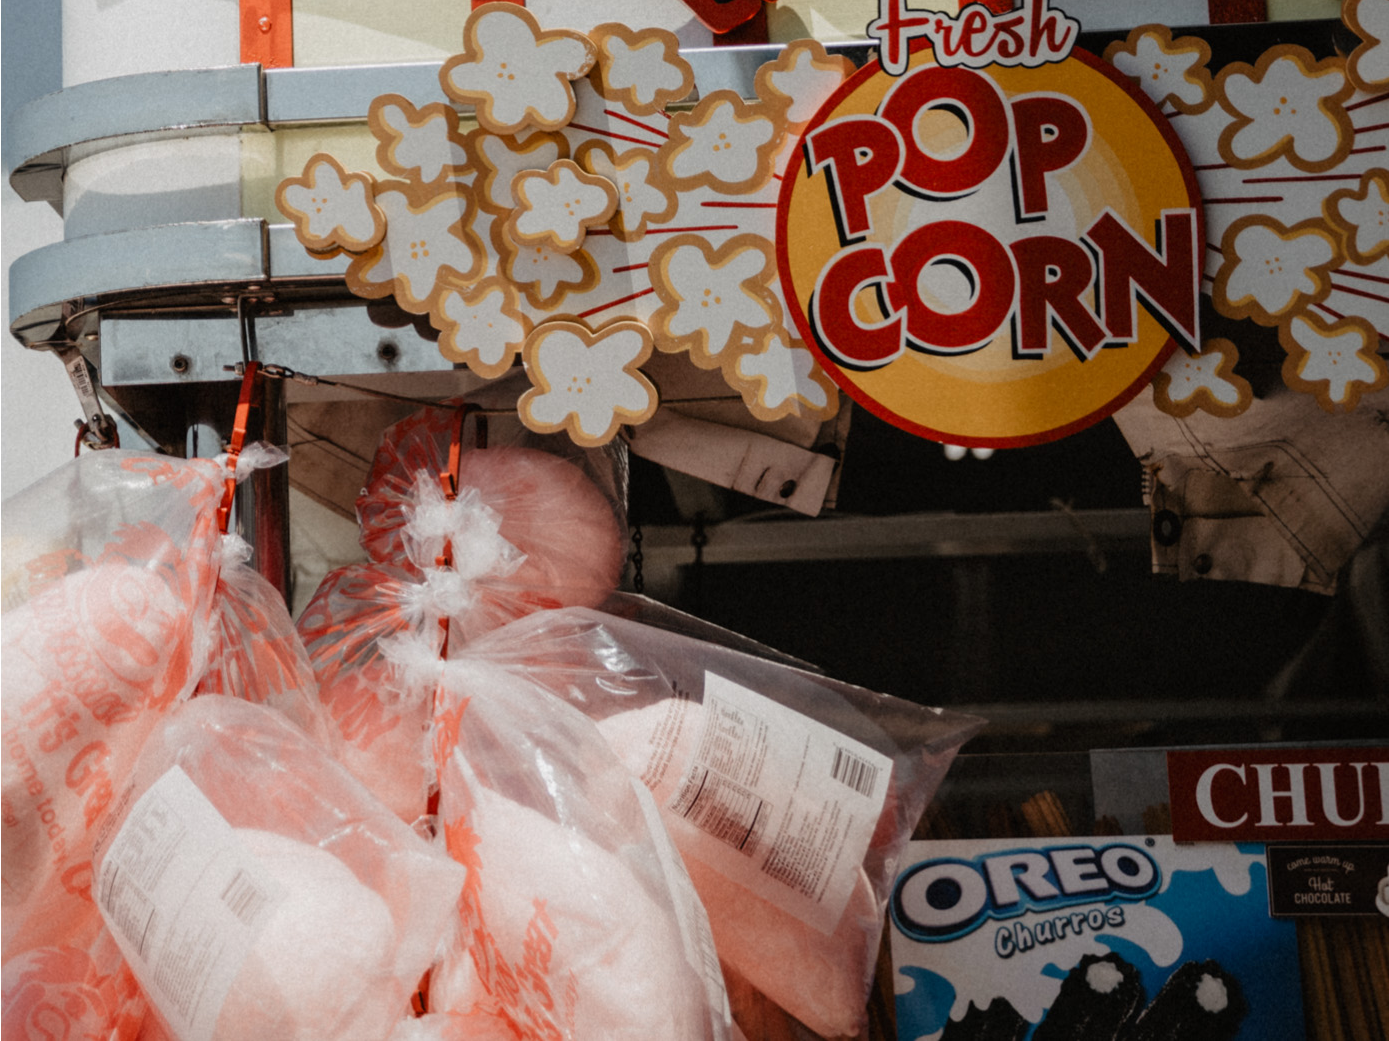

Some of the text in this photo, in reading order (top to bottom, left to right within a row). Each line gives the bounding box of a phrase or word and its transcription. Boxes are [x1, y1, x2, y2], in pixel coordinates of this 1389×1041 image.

[807, 65, 1090, 243] POP
[809, 207, 1202, 369] CORN
[899, 844, 1155, 930] OREO
[1286, 856, 1312, 871] come
[1312, 856, 1342, 866] warm
[1342, 861, 1356, 874] up
[1308, 877, 1335, 892] Hot
[1294, 893, 1352, 905] CHOCOLATE
[995, 904, 1126, 959] Churros
